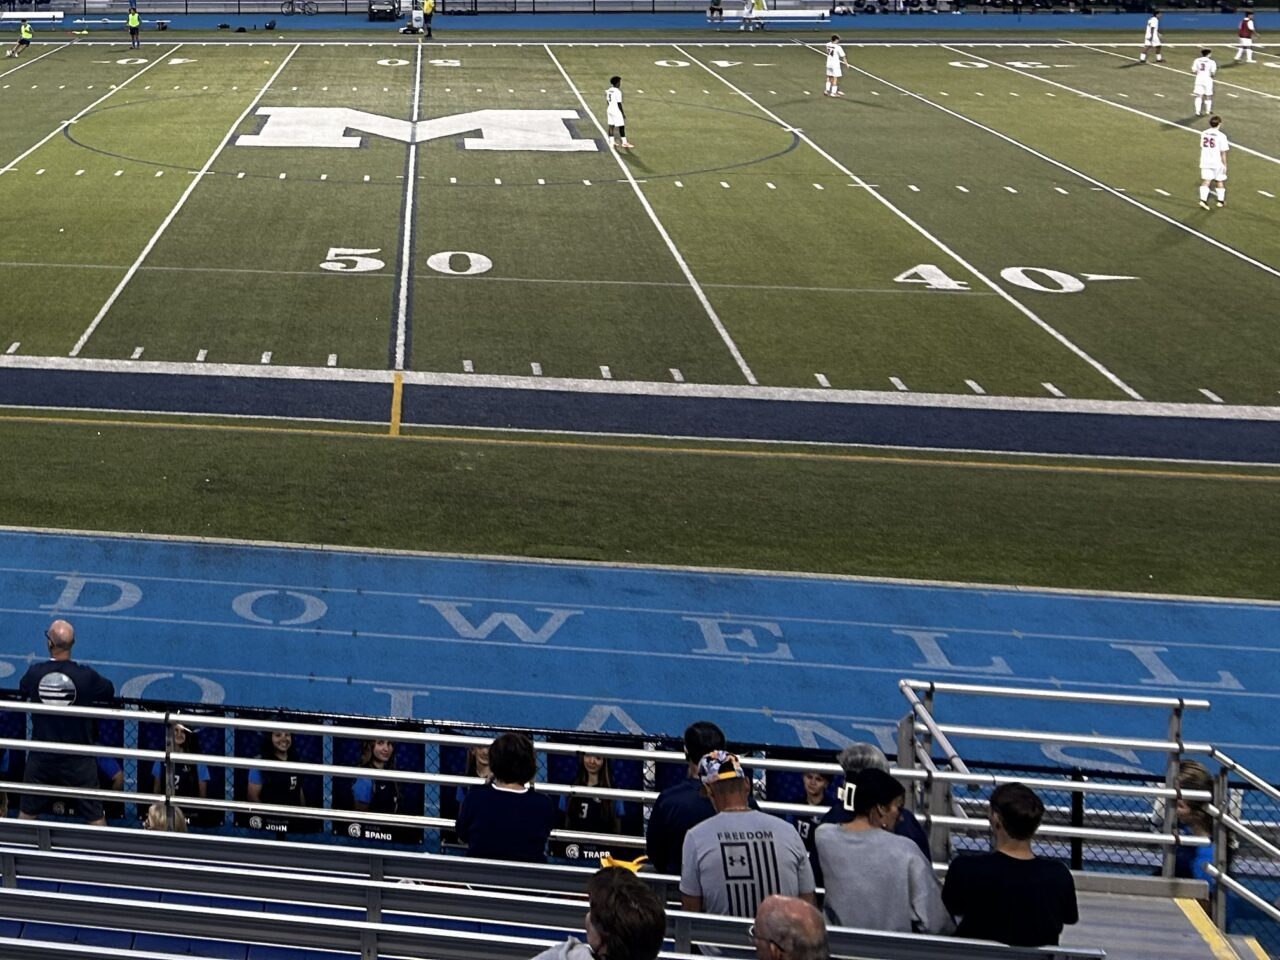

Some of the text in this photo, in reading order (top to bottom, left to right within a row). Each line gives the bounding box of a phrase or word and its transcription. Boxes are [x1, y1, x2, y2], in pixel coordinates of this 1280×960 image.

[235, 106, 599, 152] M
[1203, 137, 1216, 149] 26
[579, 802, 589, 819] 3
[265, 824, 288, 833] JOHN
[798, 820, 810, 839] 13
[364, 830, 393, 841] SPANO
[717, 831, 774, 841] FREEDOM
